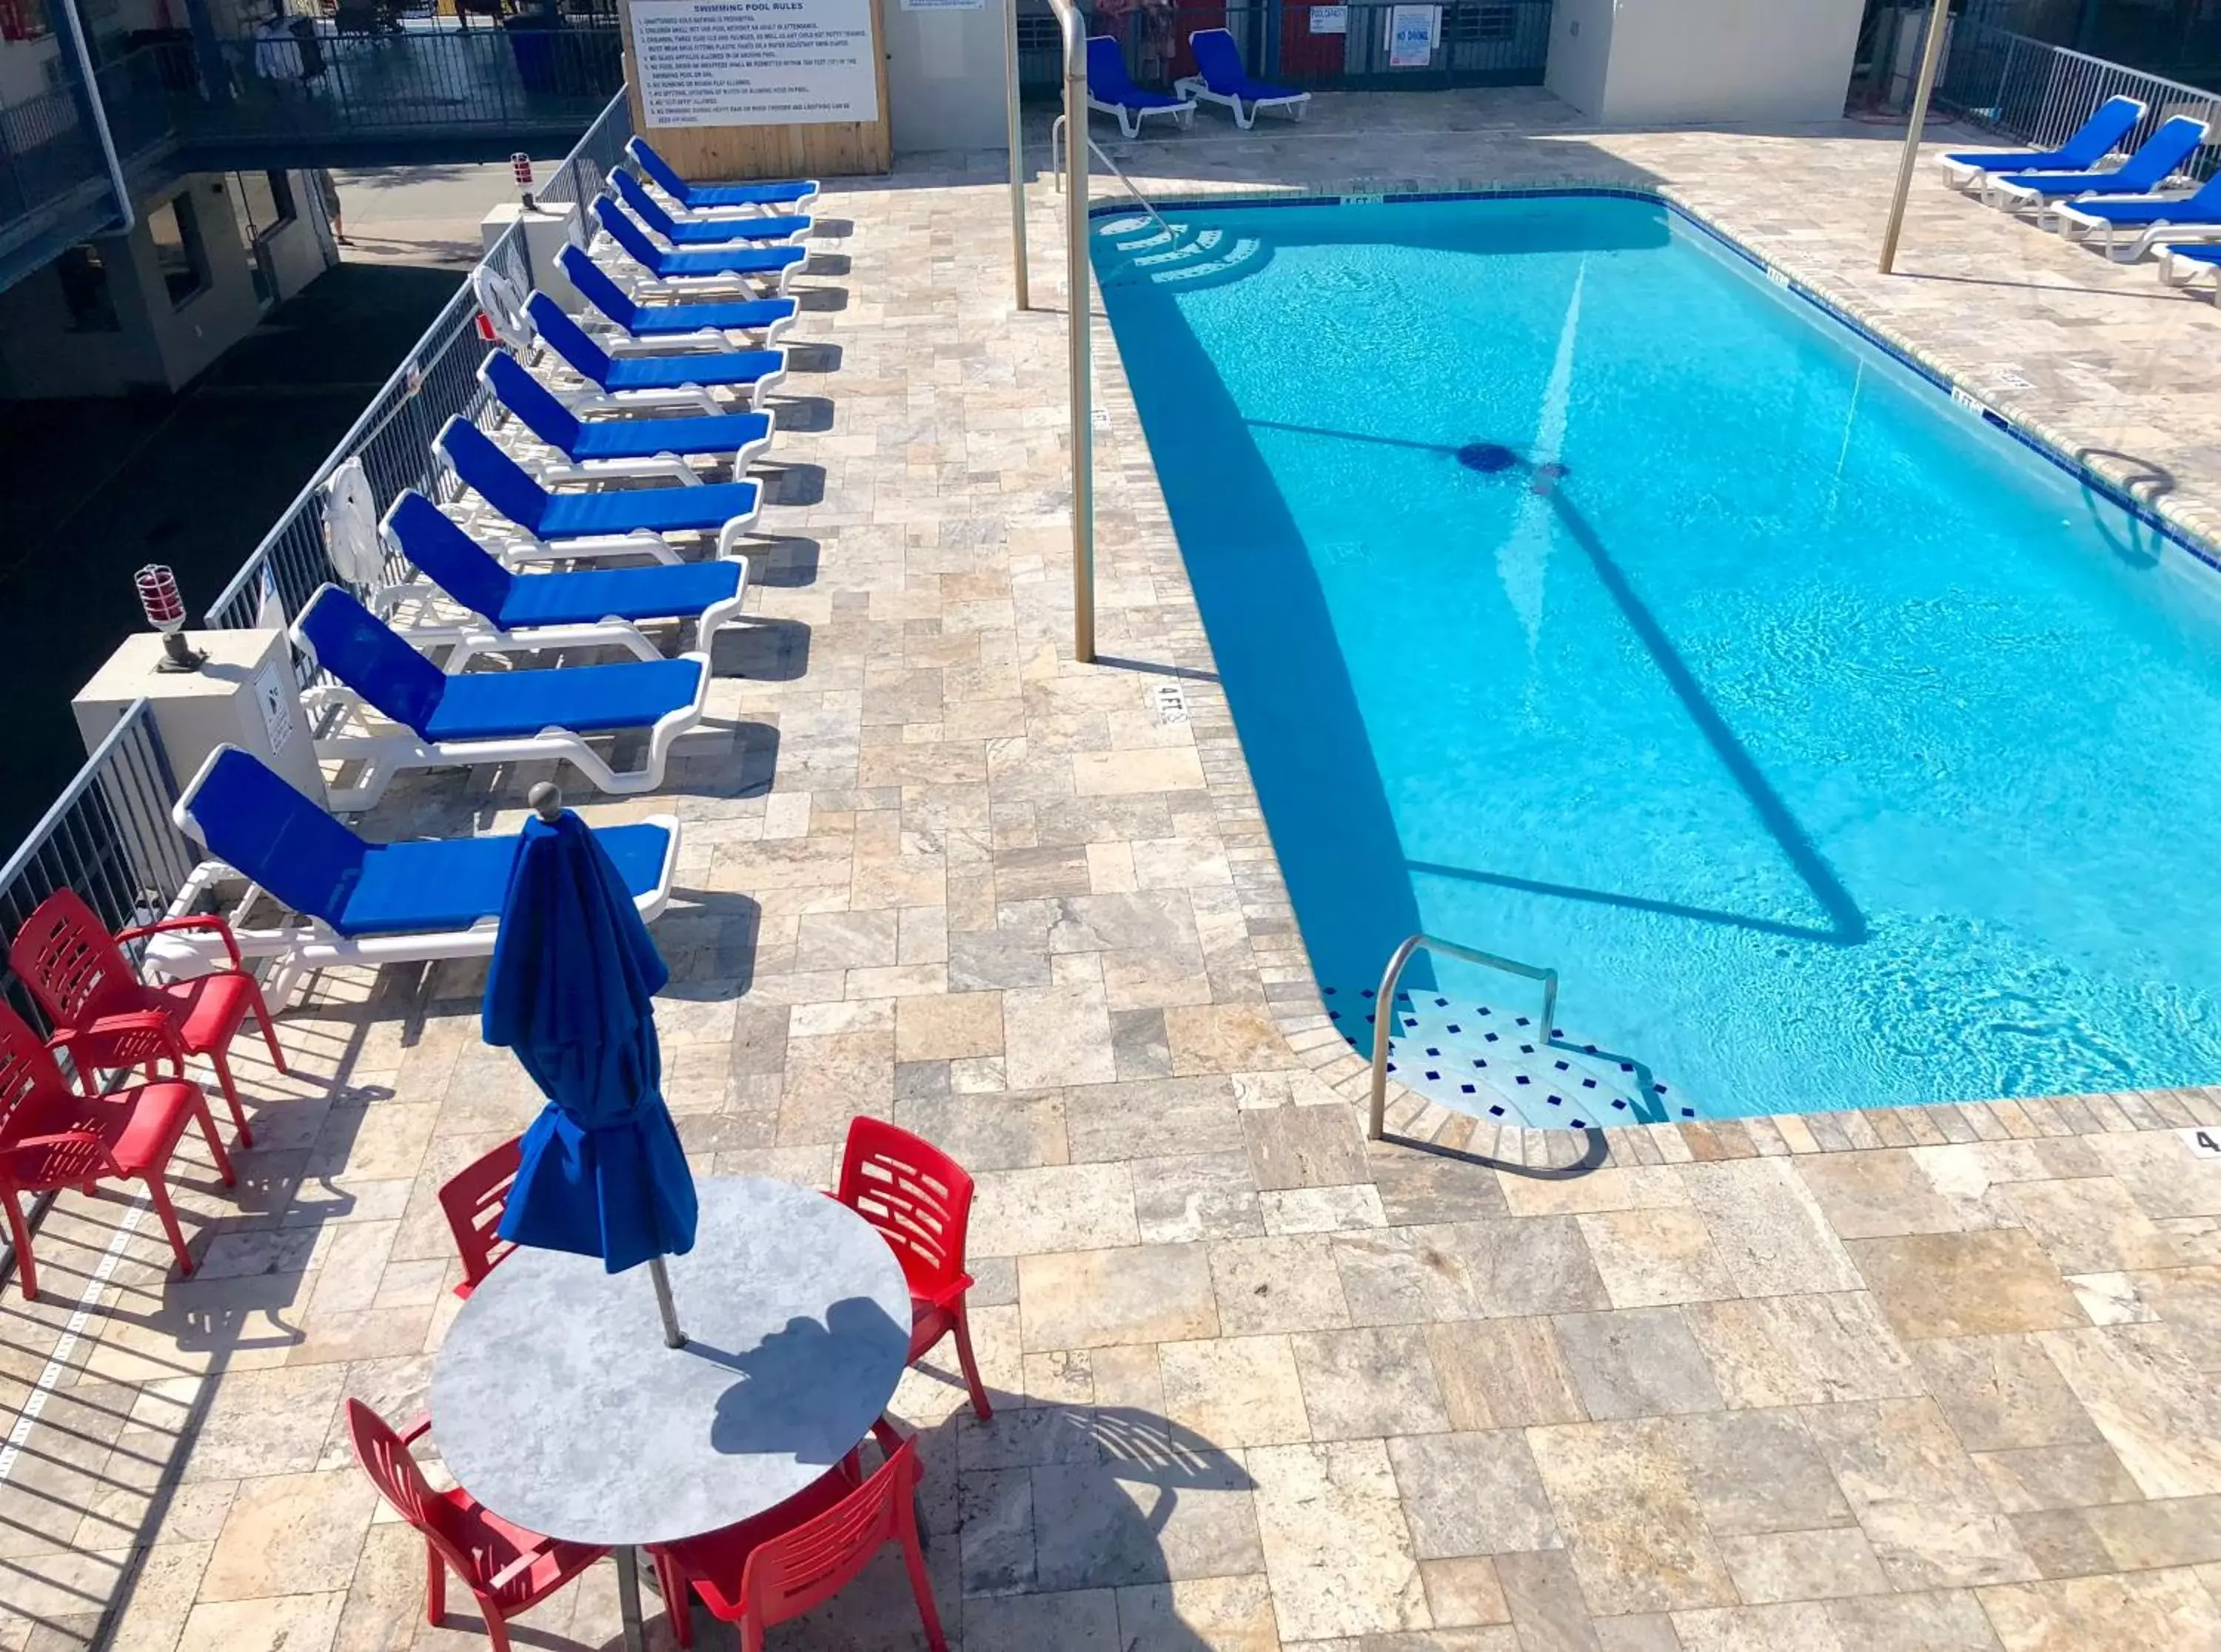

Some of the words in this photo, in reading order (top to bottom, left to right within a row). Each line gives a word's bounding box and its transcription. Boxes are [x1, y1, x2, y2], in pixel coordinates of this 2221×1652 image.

[694, 4, 742, 13] SWIMMING
[746, 3, 771, 11] POOL
[772, 2, 803, 10] RULES
[2196, 1131, 2221, 1152] 4
